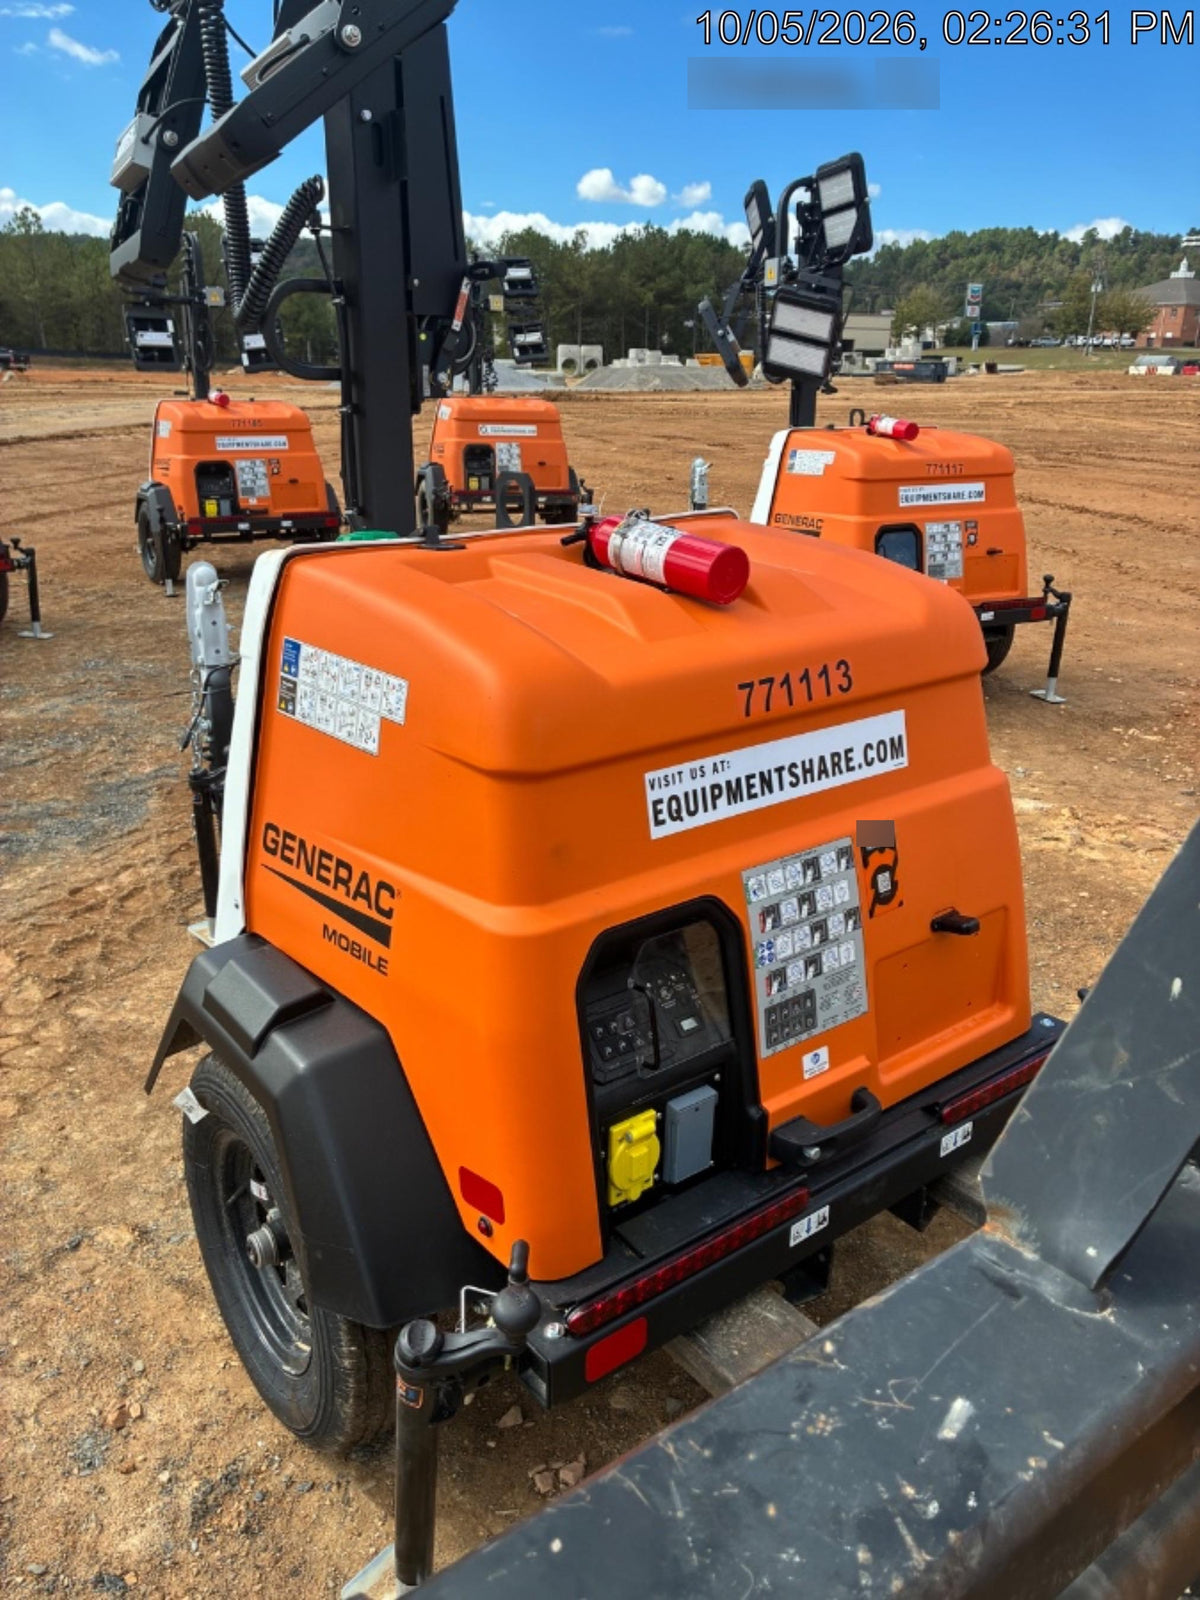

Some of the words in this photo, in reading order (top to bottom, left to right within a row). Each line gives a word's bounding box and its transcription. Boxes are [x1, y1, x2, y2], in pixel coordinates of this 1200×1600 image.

[926, 463, 964, 475] 771117
[774, 513, 825, 530] GENERAC
[738, 659, 853, 717] 771113
[648, 771, 684, 791] VISIT
[689, 765, 706, 780] US
[712, 760, 731, 775] AT:
[651, 734, 905, 827] EQUIPMENTSHARE.COM
[262, 822, 396, 920] GENERAC
[322, 923, 389, 976] MOBILE
